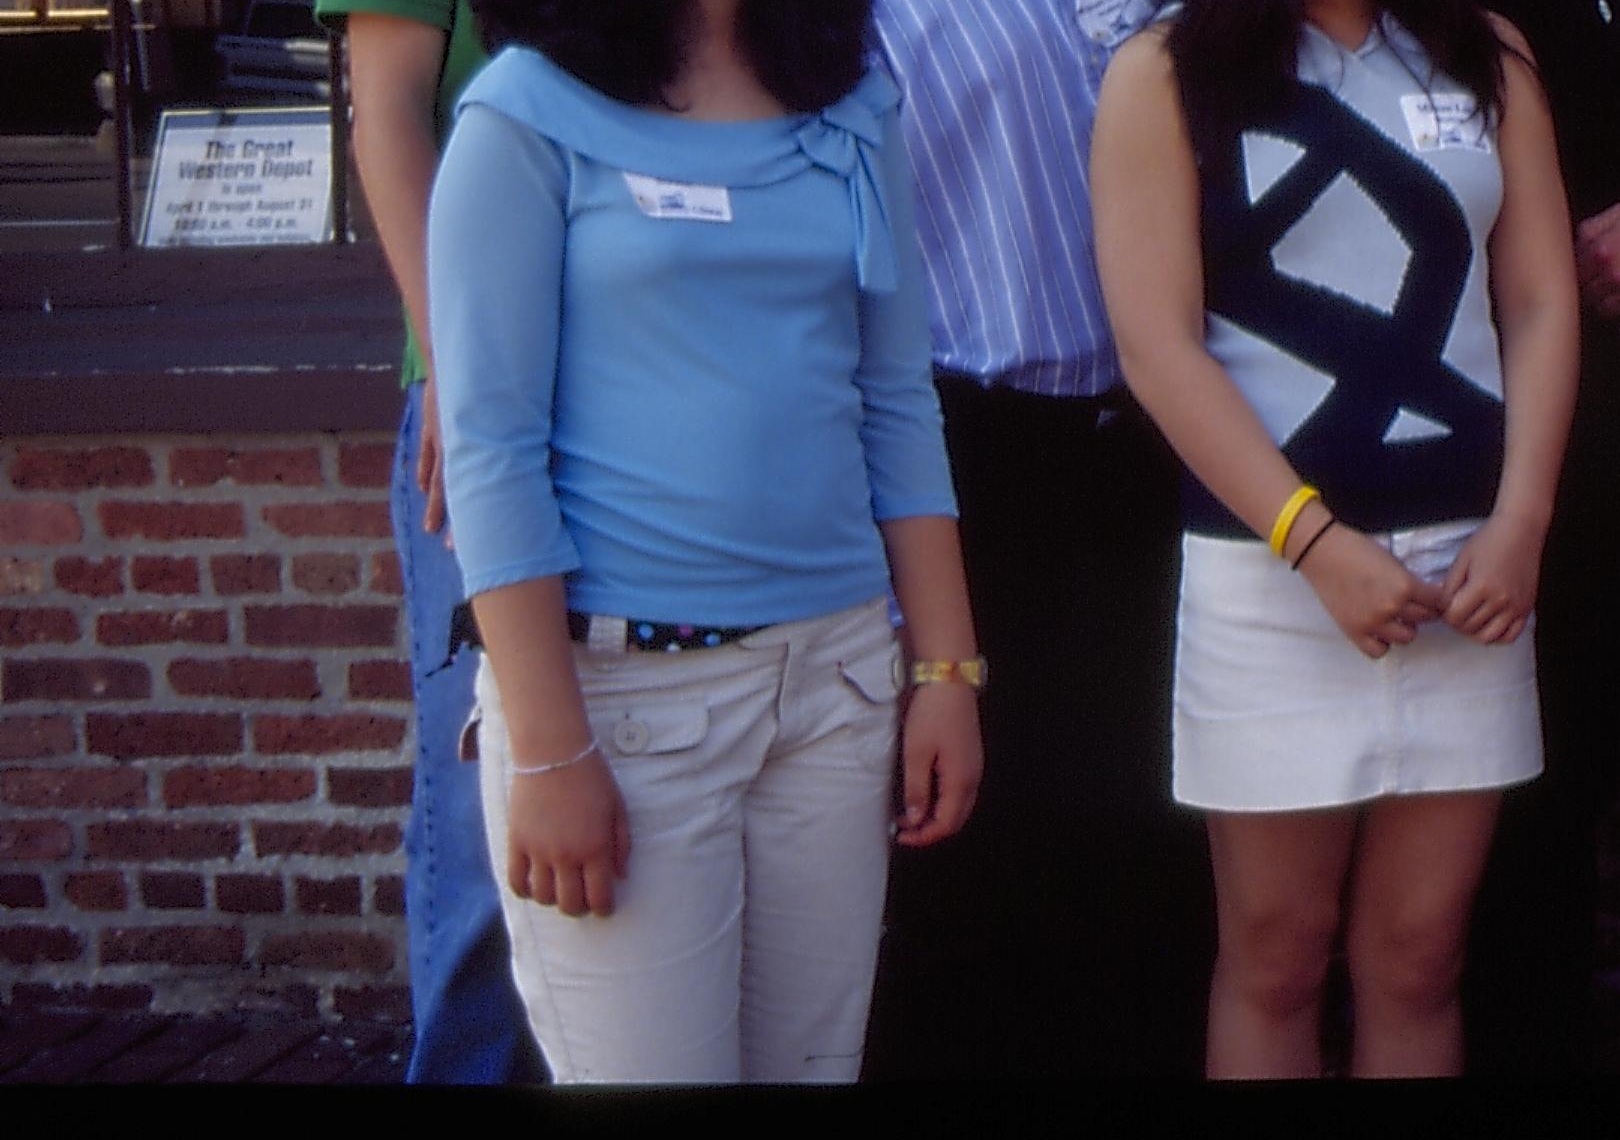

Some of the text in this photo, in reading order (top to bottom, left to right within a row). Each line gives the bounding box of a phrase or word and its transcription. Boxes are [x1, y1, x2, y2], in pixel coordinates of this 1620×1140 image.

[206, 140, 293, 158] The Great
[179, 160, 313, 180] Western Depot
